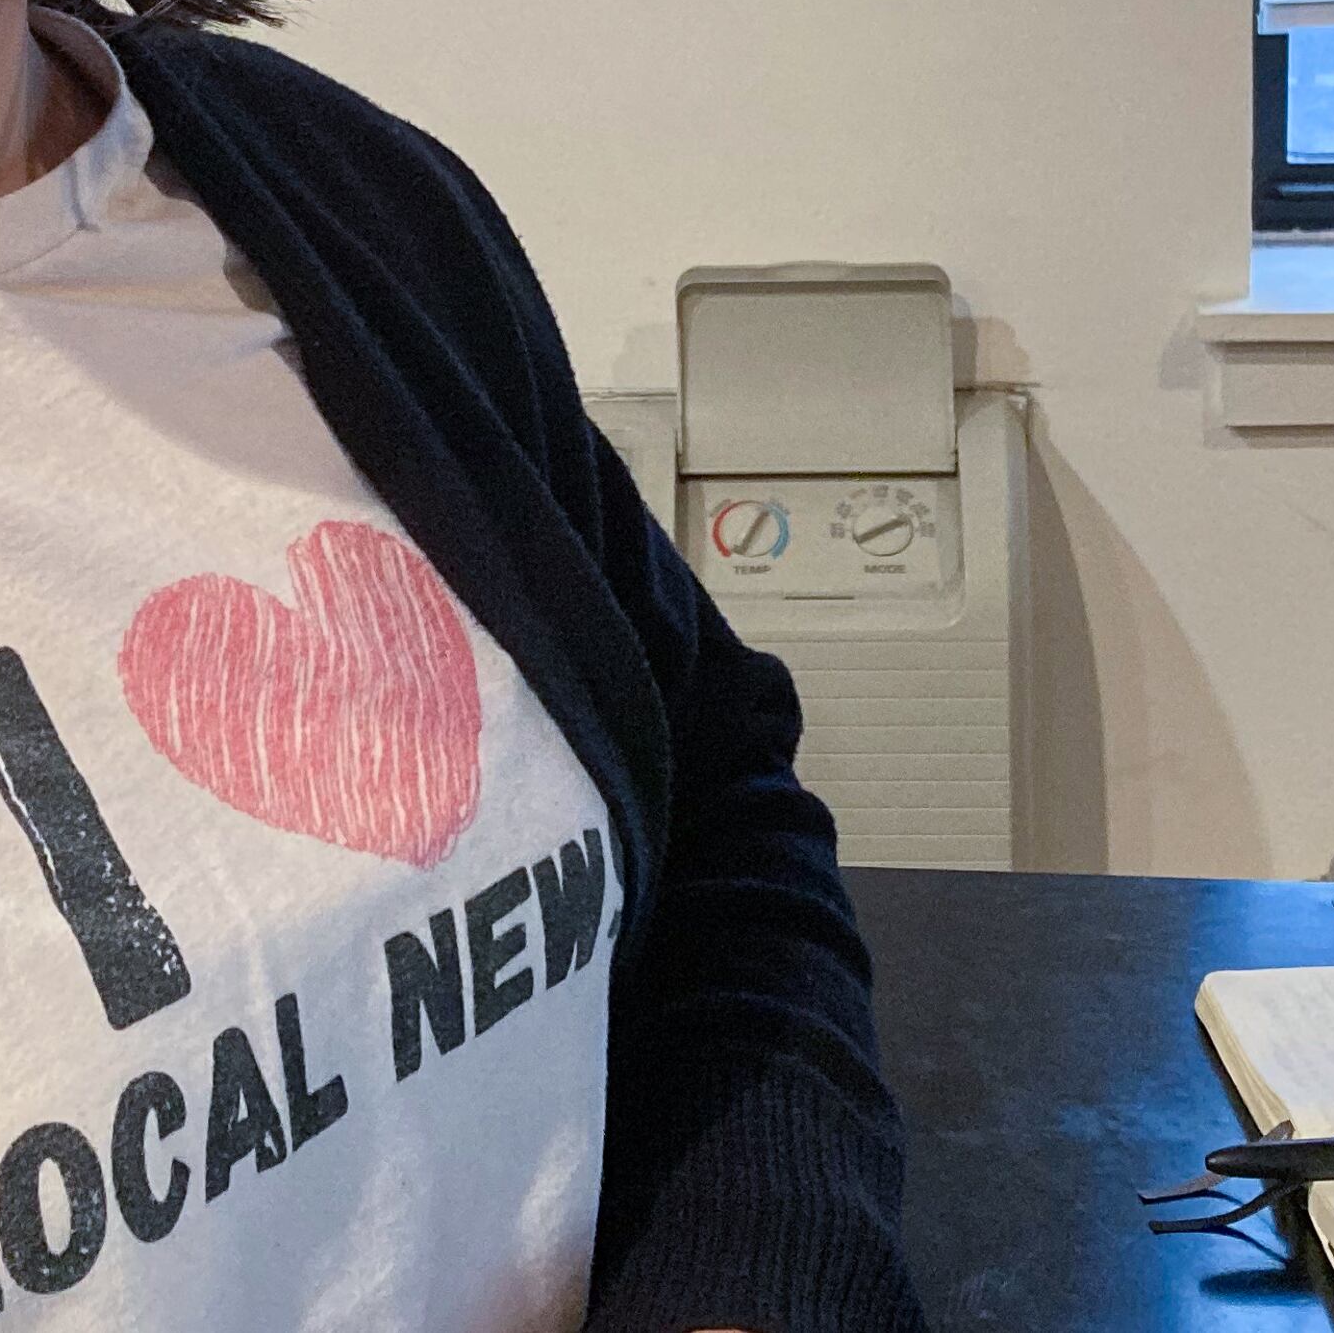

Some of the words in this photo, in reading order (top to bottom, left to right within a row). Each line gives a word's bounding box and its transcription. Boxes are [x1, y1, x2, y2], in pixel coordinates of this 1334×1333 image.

[733, 565, 771, 575] TEMP
[864, 564, 907, 574] MODE
[384, 827, 622, 1082] NEW
